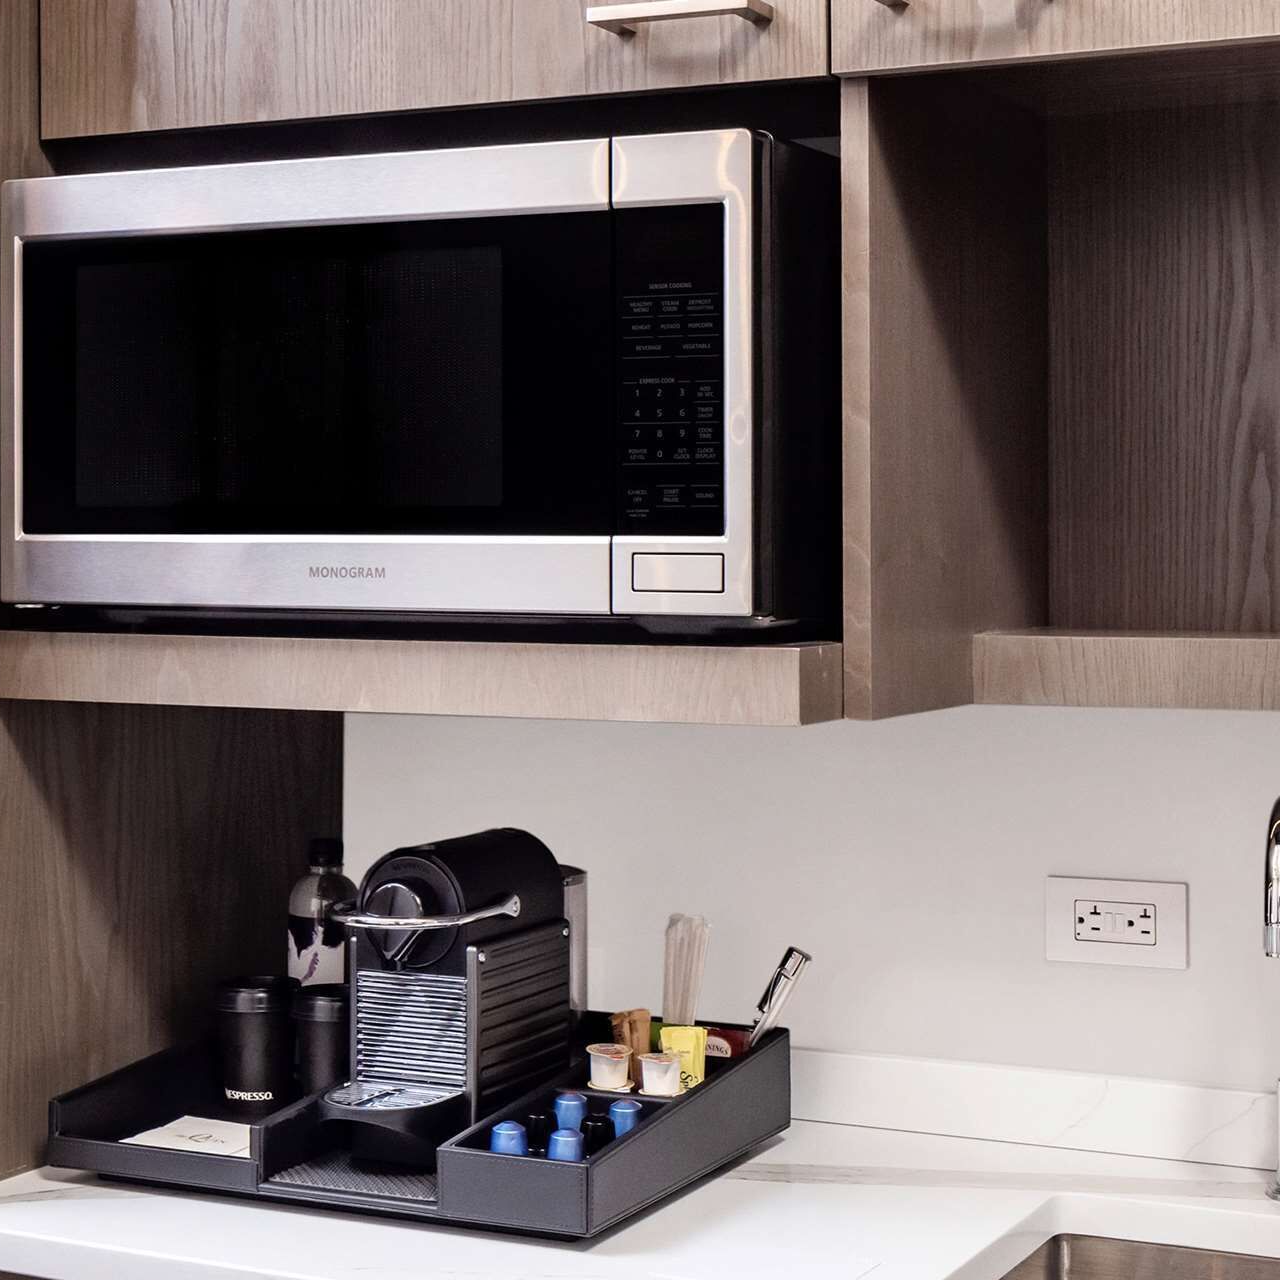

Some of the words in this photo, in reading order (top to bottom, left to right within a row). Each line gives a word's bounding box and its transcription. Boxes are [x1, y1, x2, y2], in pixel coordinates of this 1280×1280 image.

[656, 388, 663, 397] 2
[679, 387, 686, 397] 3
[634, 409, 641, 417] 4
[656, 408, 663, 417] 5
[679, 408, 686, 417] 6
[634, 429, 641, 438] 7
[679, 429, 686, 438] 9
[656, 449, 663, 458] 0
[308, 566, 386, 578] MONOGRAM
[706, 1043, 729, 1056] NINGS
